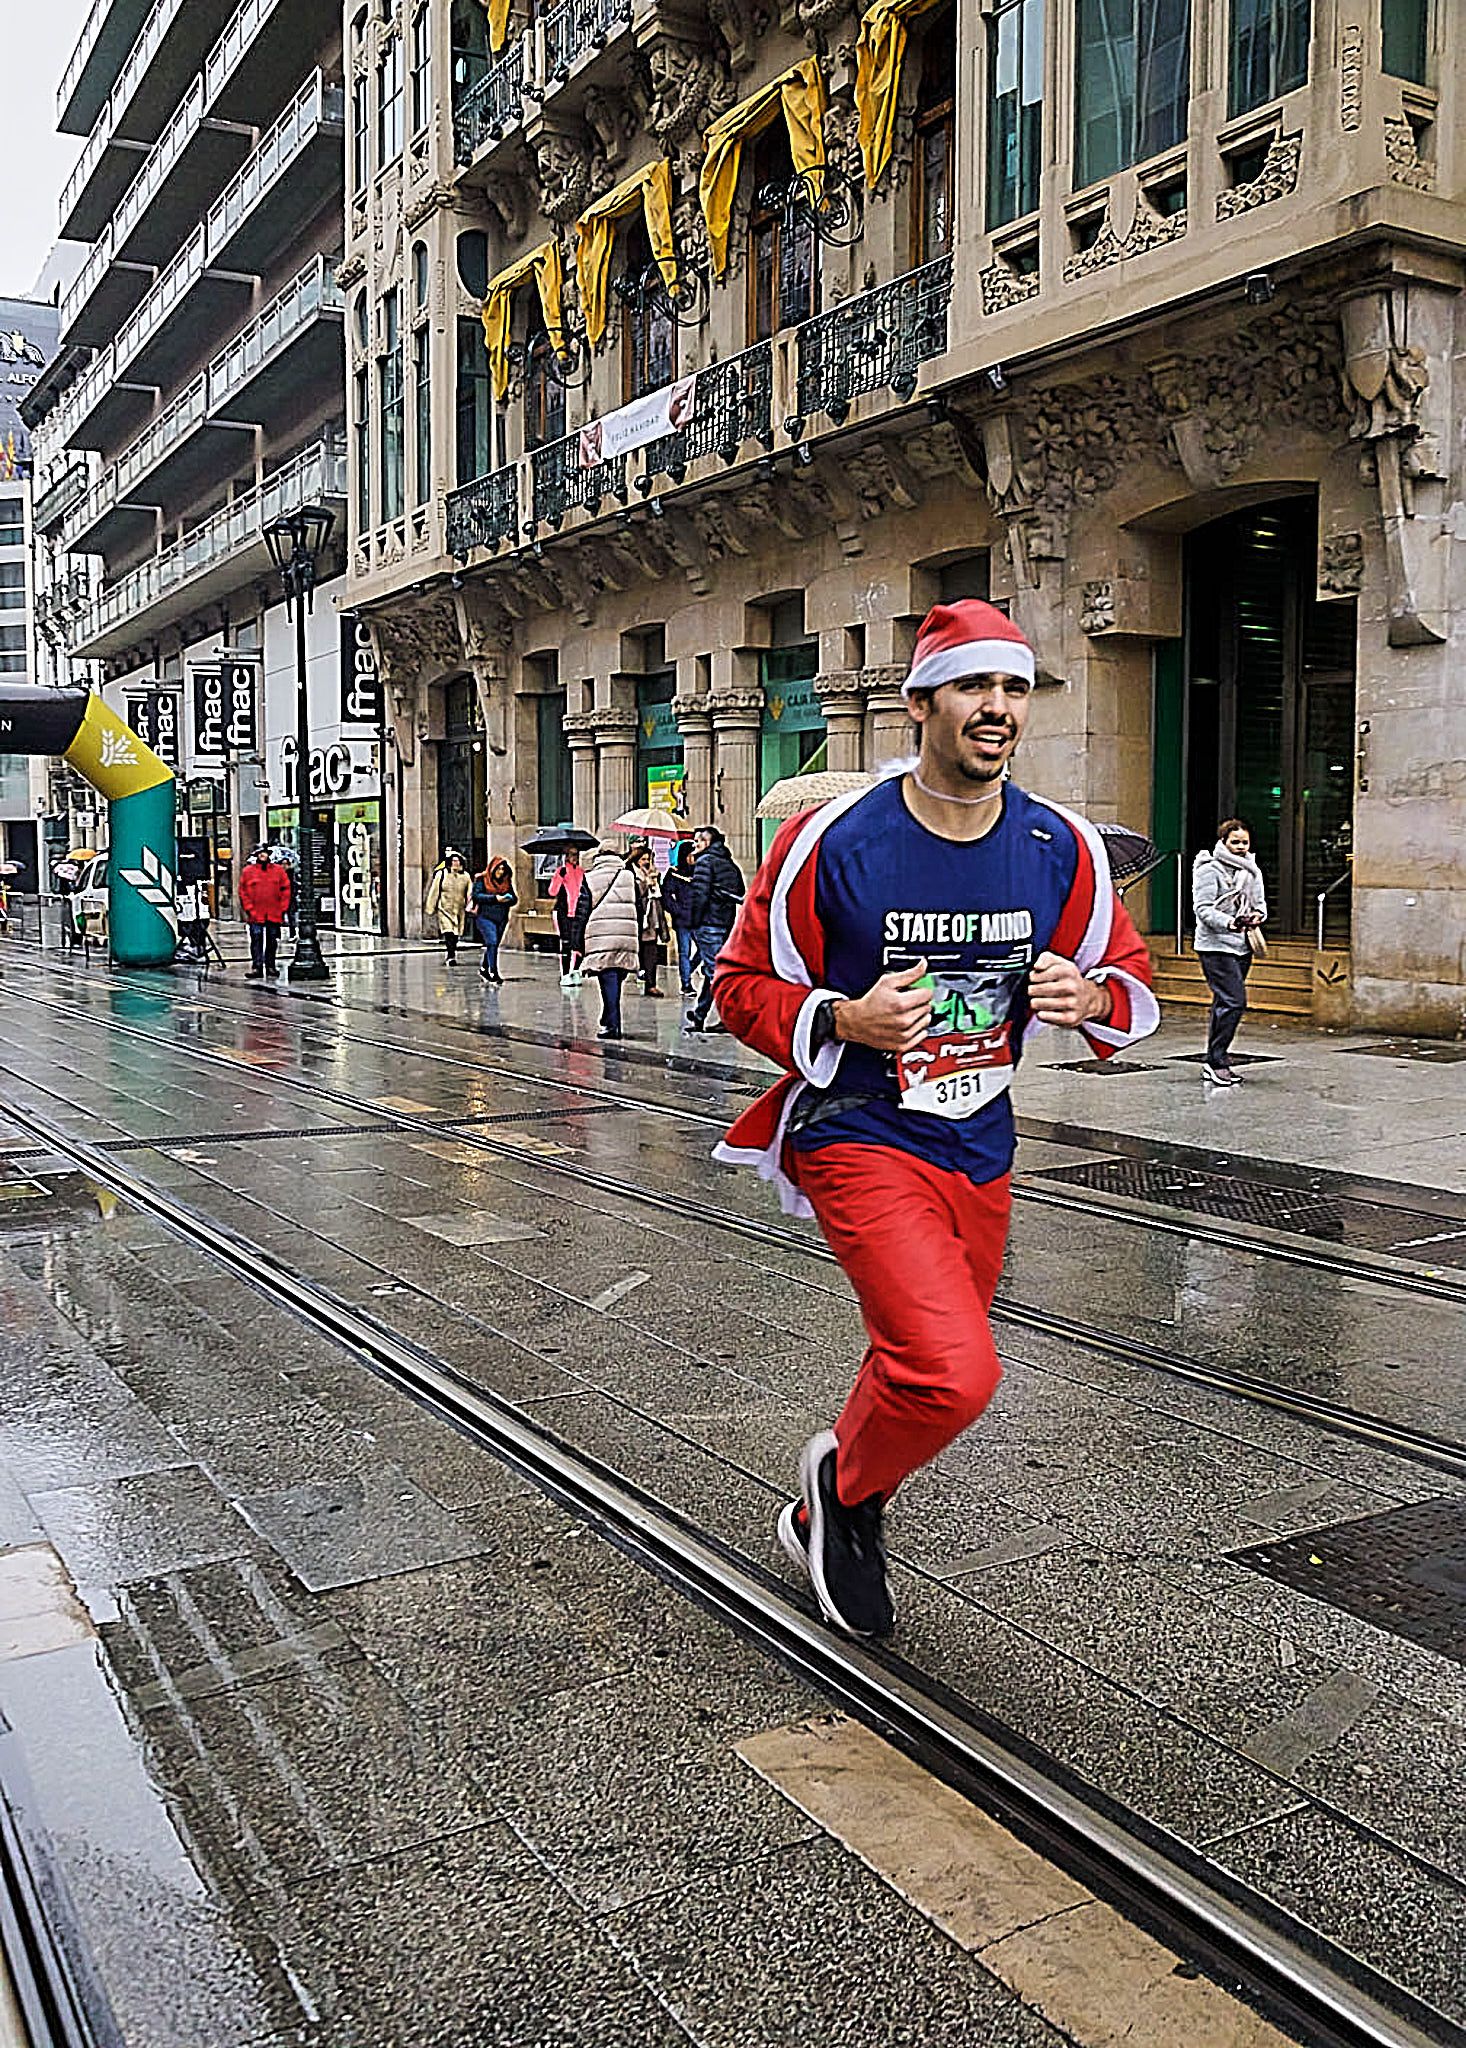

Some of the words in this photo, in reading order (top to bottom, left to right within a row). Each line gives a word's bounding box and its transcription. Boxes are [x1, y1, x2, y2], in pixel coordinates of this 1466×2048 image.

[227, 668, 251, 746] fnac
[346, 623, 376, 717] fnac
[153, 696, 175, 761] fnac
[199, 678, 223, 751] fnac
[342, 822, 369, 910] fnac
[936, 1072, 981, 1104] 3751
